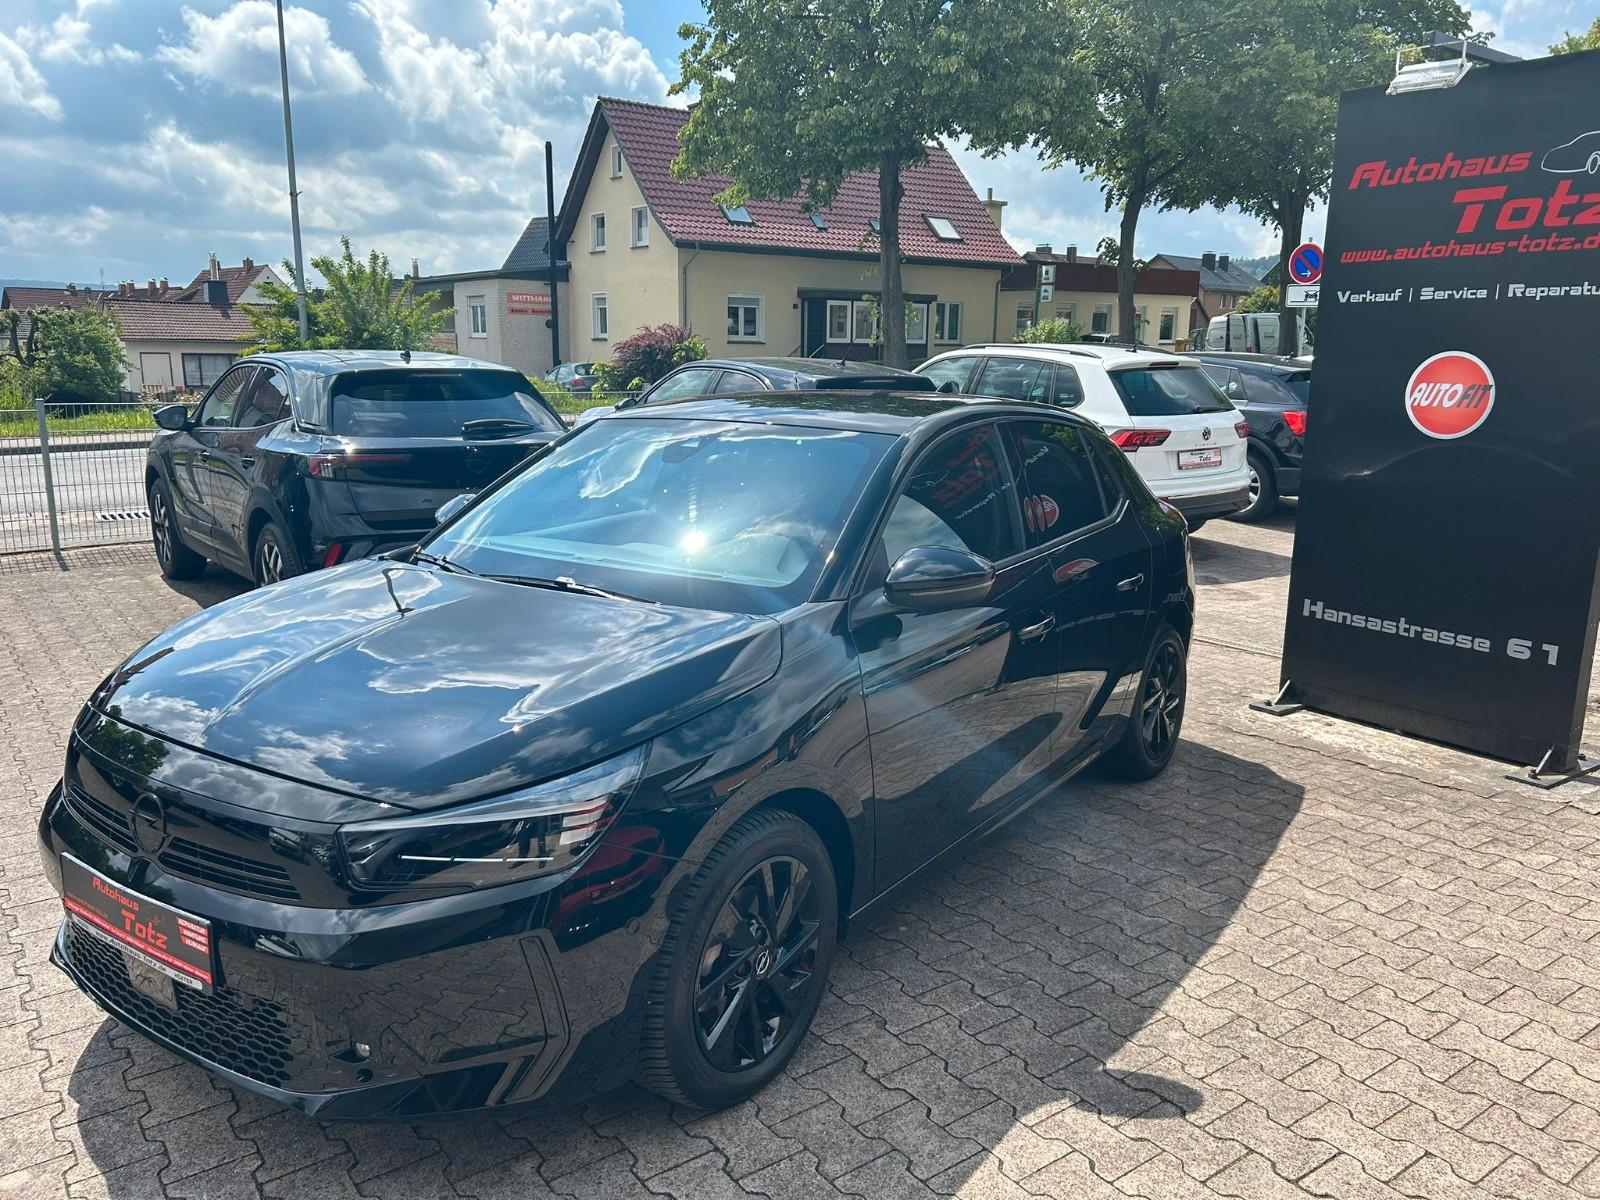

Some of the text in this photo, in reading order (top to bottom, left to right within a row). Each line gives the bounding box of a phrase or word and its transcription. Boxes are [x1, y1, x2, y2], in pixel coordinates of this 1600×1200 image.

[1349, 152, 1533, 190] Autohaus
[1452, 179, 1600, 234] Totz
[1337, 288, 1402, 304] Verkauf
[1419, 285, 1488, 301] Service
[1409, 382, 1493, 409] AUTOFIT
[1302, 598, 1560, 666] Hansastrasse 61
[92, 876, 140, 912] Autohaus
[121, 908, 169, 950] Totz
